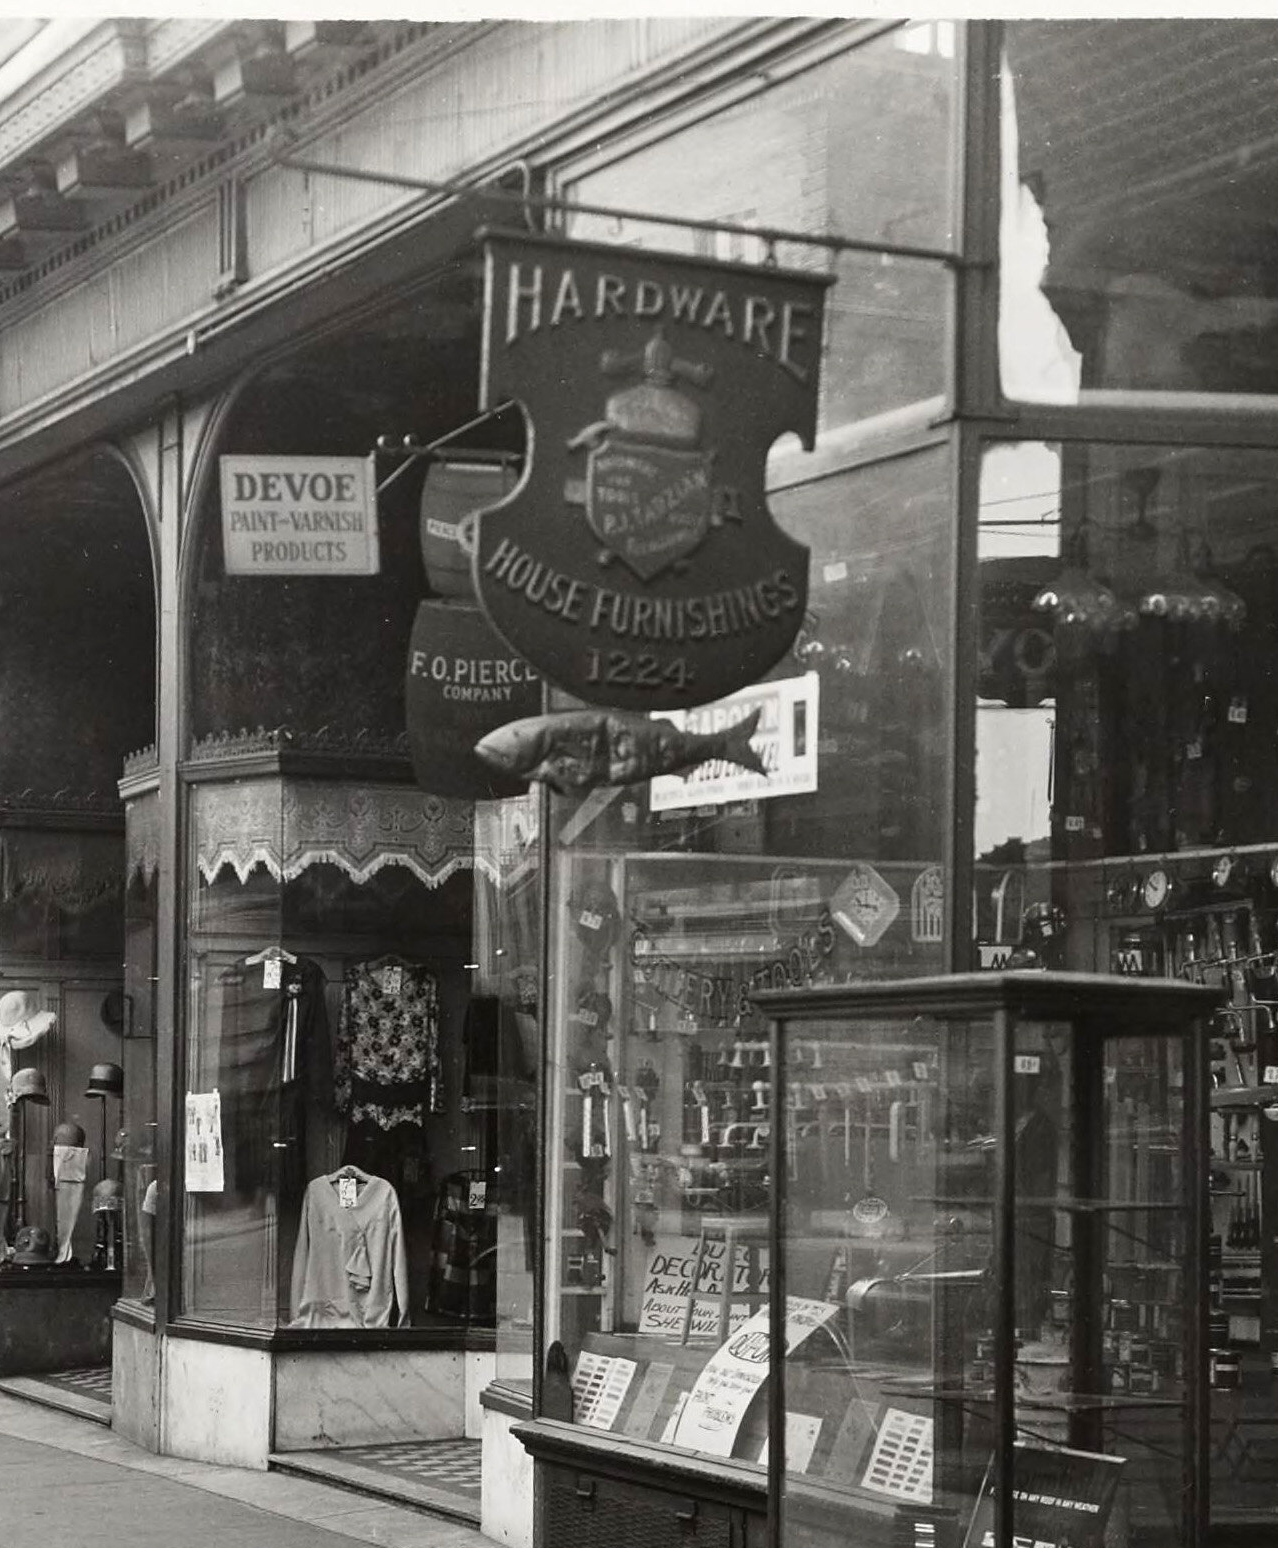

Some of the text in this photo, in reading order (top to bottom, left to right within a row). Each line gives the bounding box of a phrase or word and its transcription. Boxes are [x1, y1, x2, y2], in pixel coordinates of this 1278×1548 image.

[506, 263, 812, 380] HARDWARE
[233, 472, 356, 502] DEVOE
[251, 541, 348, 562] PRODUCTS
[485, 538, 799, 638] HOUSE FURNISHINGS
[583, 648, 694, 690] 1224
[442, 684, 513, 701] COMPANY
[643, 1297, 687, 1314] ABOUT
[645, 1314, 719, 1333] SHE WIL
